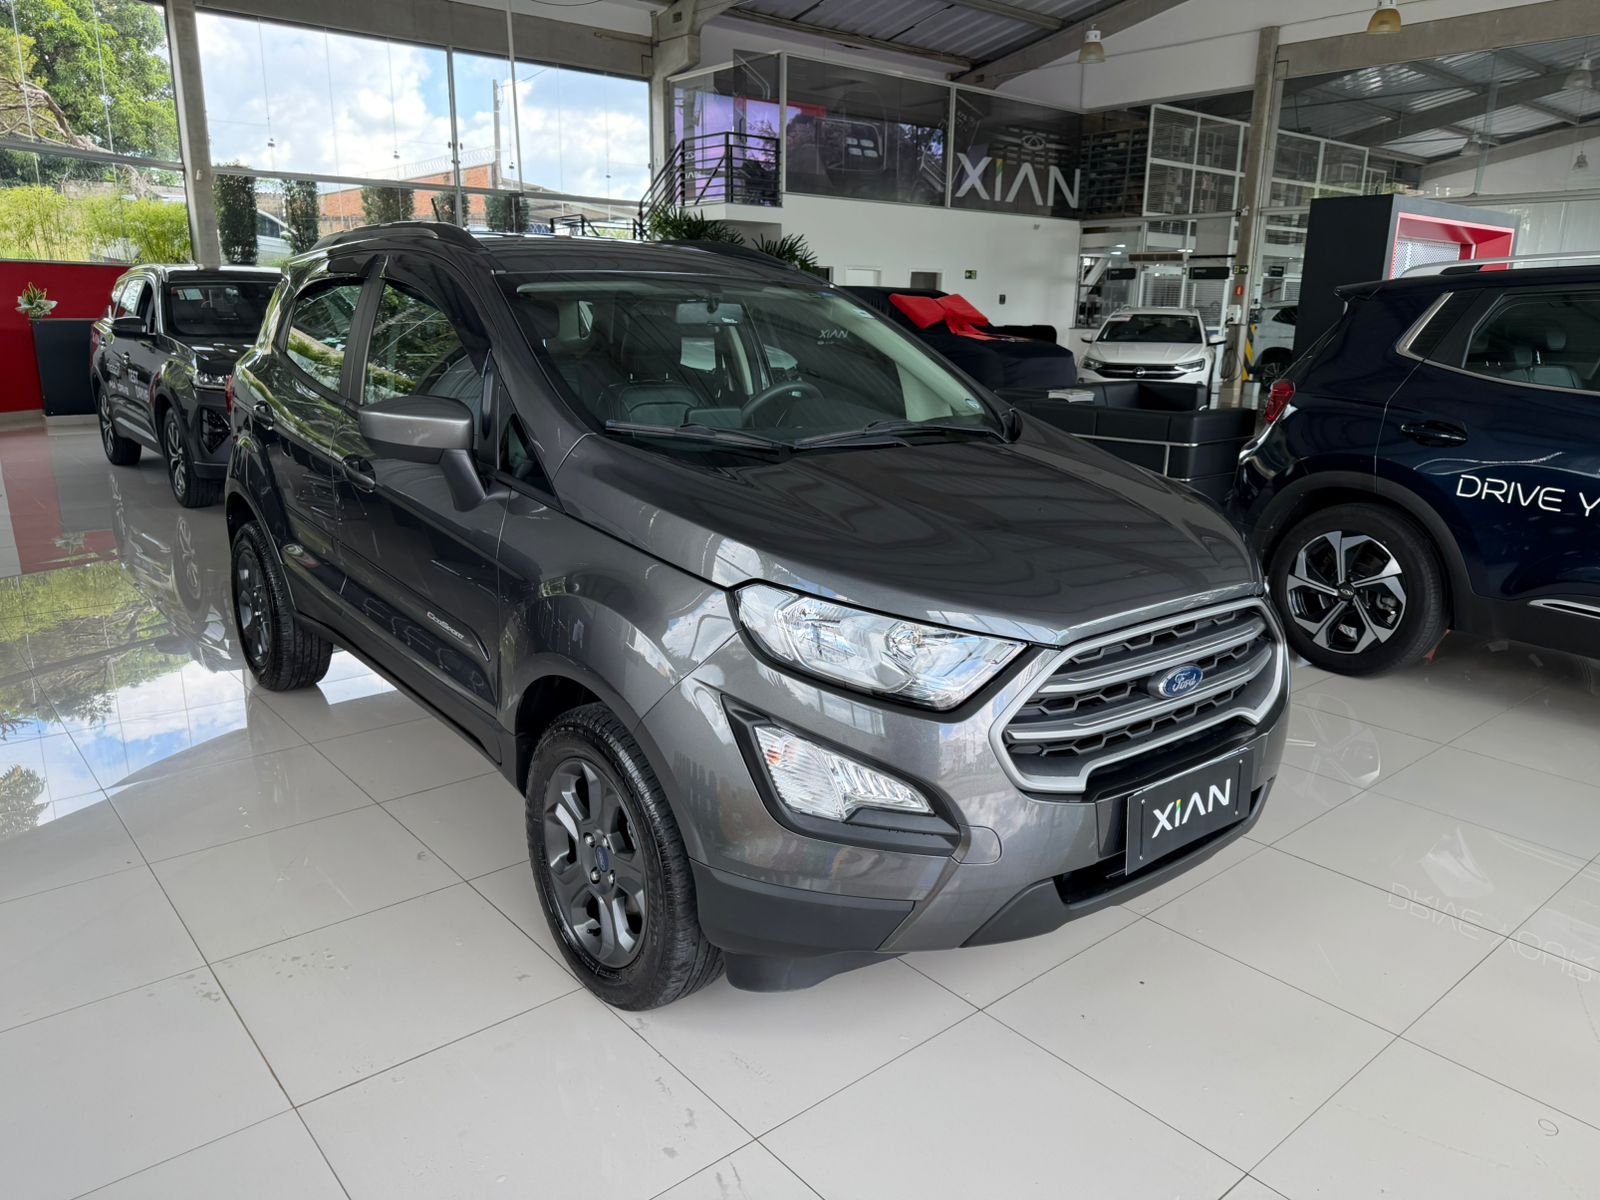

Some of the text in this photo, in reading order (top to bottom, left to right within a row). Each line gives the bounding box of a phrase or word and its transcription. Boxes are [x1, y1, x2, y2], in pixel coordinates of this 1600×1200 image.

[955, 152, 1081, 209] XIAN
[819, 329, 849, 338] XIAN
[1456, 474, 1566, 512] DRIVE
[1171, 671, 1199, 693] Ford
[1151, 778, 1231, 838] XIAN
